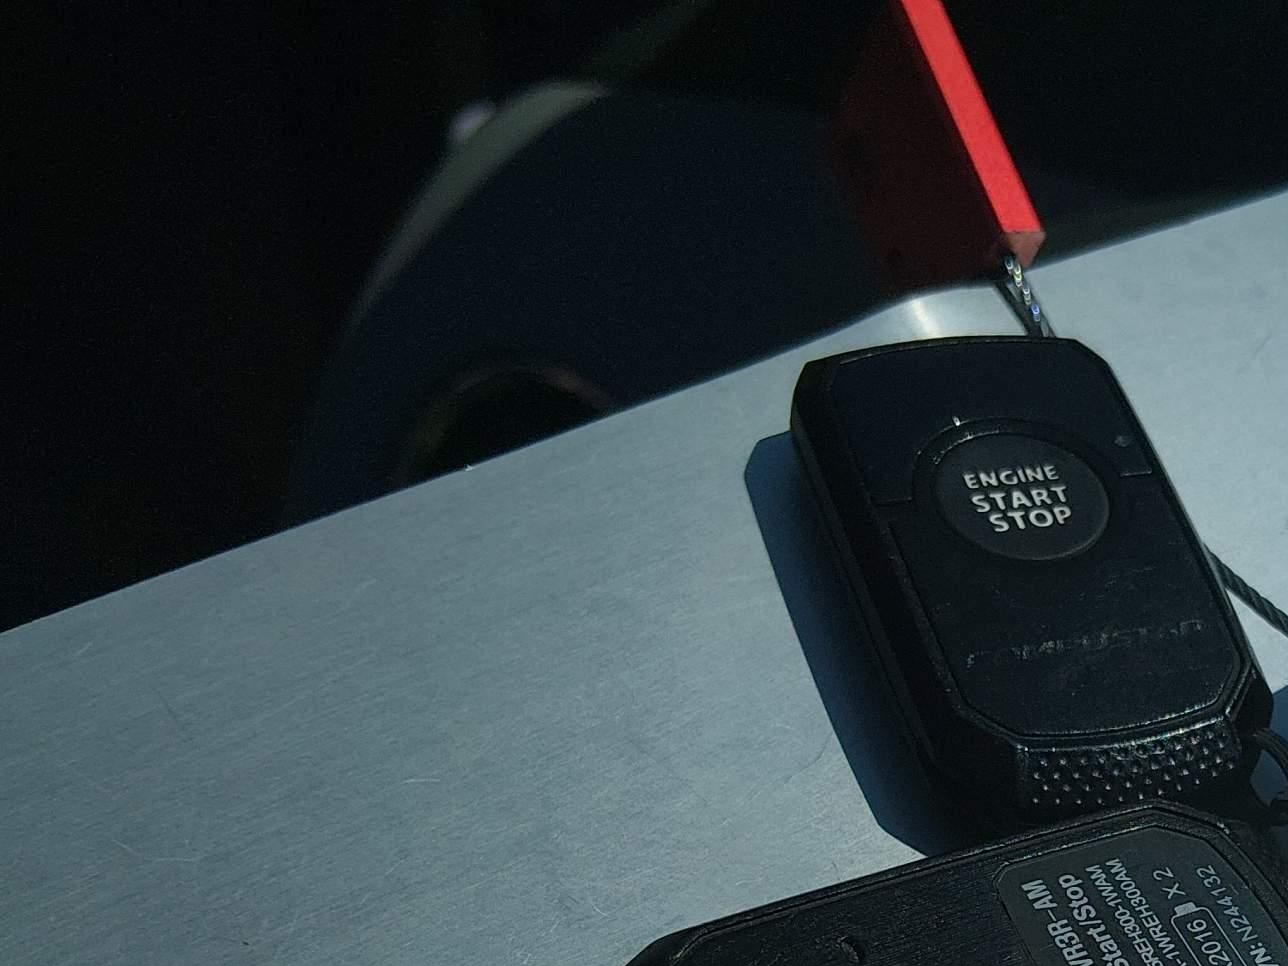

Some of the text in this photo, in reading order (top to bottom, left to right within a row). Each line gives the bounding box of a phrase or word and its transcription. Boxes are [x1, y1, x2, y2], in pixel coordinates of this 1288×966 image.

[963, 465, 1060, 489] ENGINE
[971, 486, 1067, 513] START
[988, 506, 1072, 532] STOP
[1153, 866, 1175, 881] 2
[1197, 865, 1259, 942] N244132
